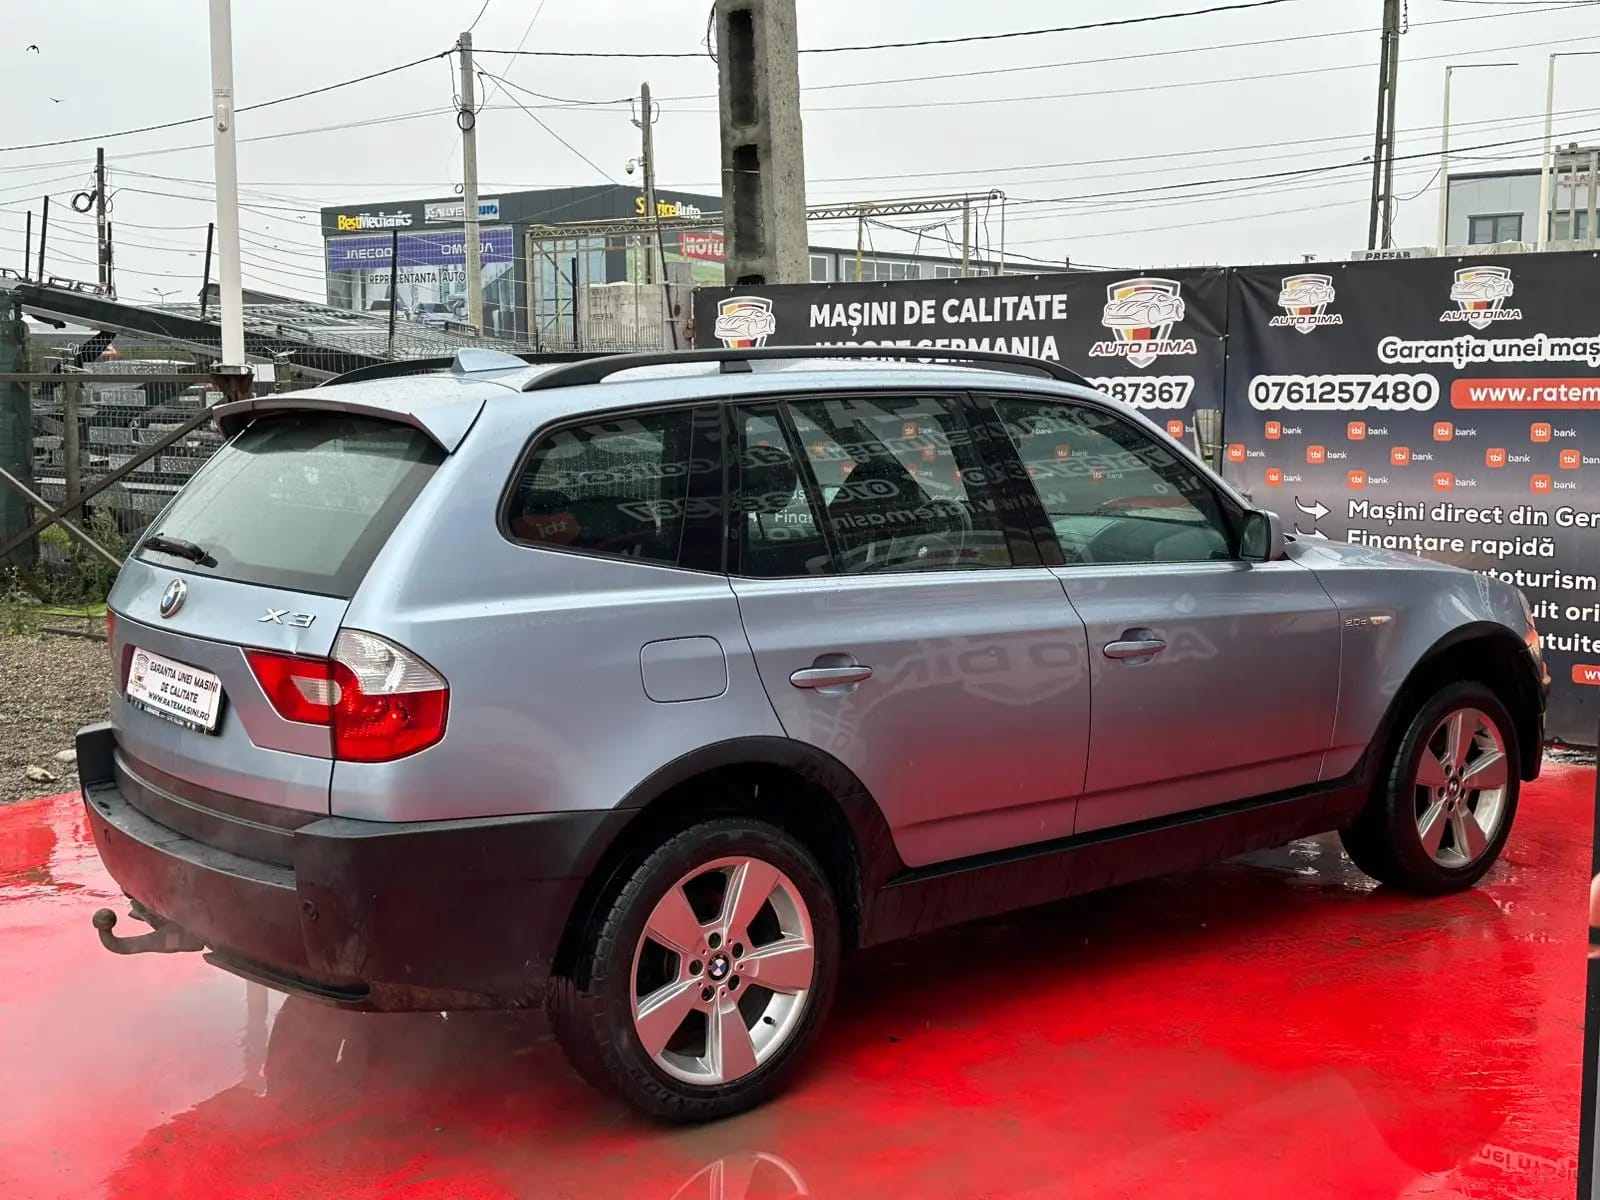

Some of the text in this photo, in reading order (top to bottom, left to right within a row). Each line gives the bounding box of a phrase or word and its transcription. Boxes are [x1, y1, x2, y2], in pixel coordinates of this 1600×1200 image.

[369, 271, 437, 285] REPRENTANTA
[810, 294, 1068, 336] MAȘINI DE CALITATE
[1270, 314, 1342, 326] AUTO DIMA
[1441, 309, 1522, 322] AUTO DIMA
[1090, 341, 1196, 356] AUTO DIMA
[1382, 339, 1485, 364] Garanția
[1493, 338, 1542, 357] unei
[1253, 380, 1433, 404] 0761257480
[1282, 426, 1302, 434] bank
[1368, 427, 1388, 435] bank
[1455, 428, 1476, 436] bank
[1554, 428, 1576, 437] bank
[1327, 451, 1347, 459] bank
[1412, 453, 1433, 461] bank
[1508, 454, 1530, 462] bank
[1283, 474, 1302, 482] bank
[1368, 476, 1388, 484] bank
[1455, 478, 1476, 487] bank
[1554, 480, 1576, 489] bank
[1348, 500, 1425, 526] Mașini
[1431, 502, 1503, 524] direct
[1508, 505, 1548, 525] din
[1347, 529, 1555, 560] Finanțare rapidă
[256, 607, 317, 628] X3
[149, 661, 219, 693] GARANTIA UNEI MASINI
[160, 682, 170, 693] DE
[169, 685, 199, 704] CALITATE
